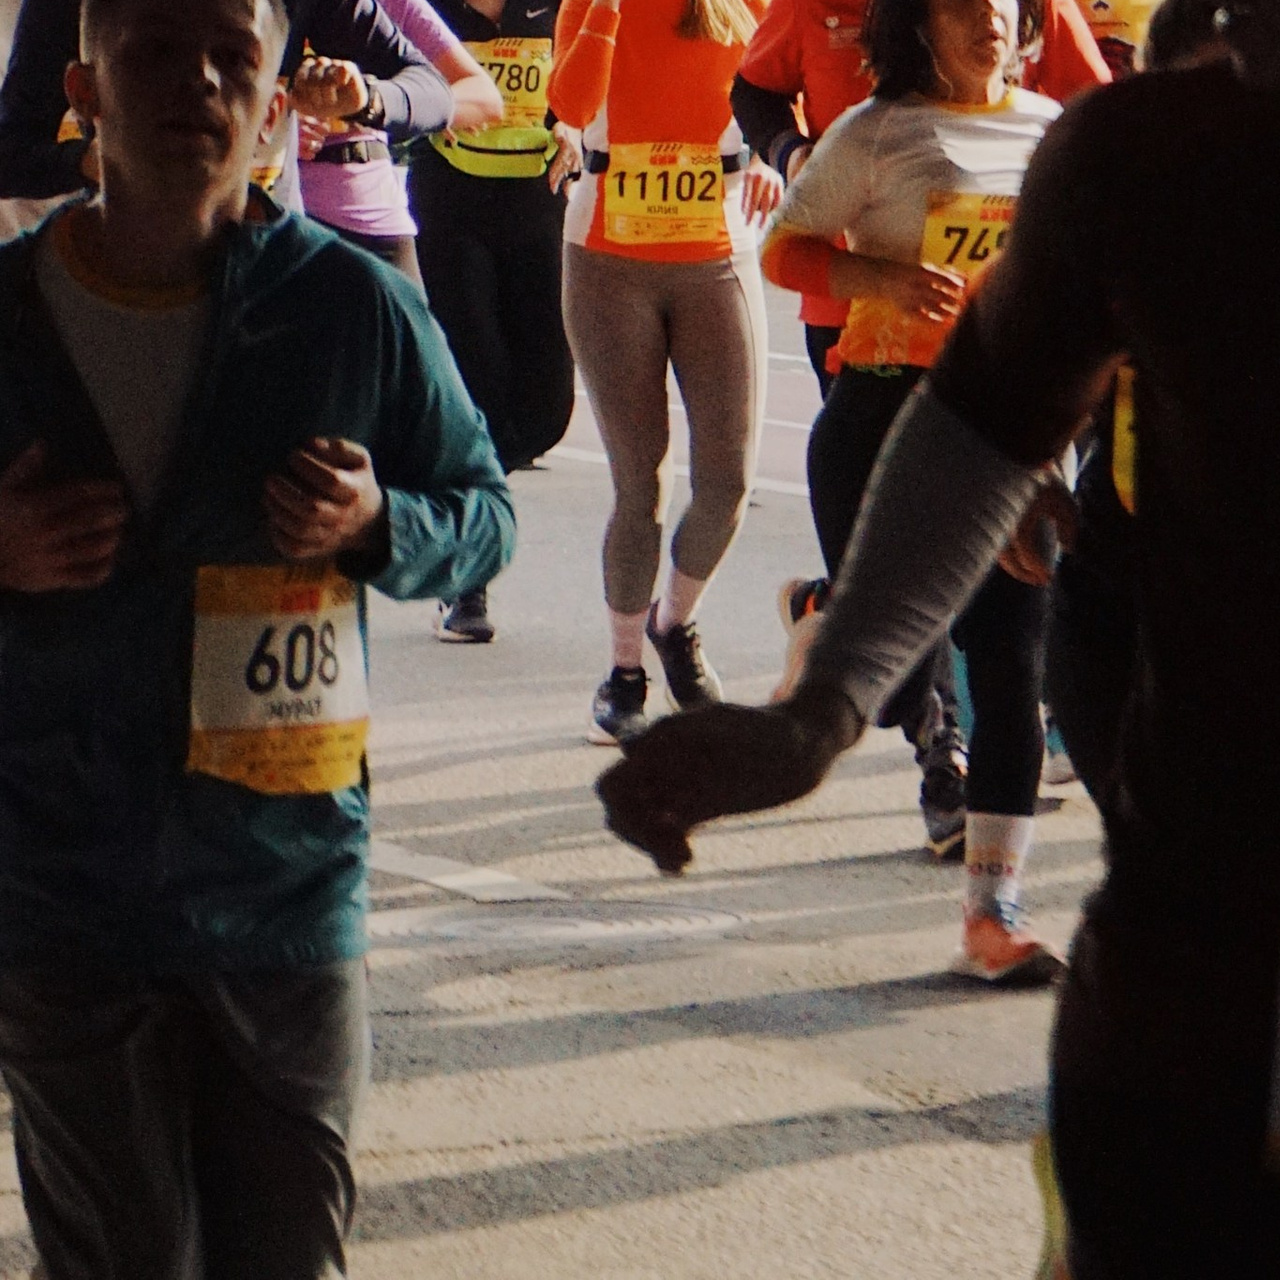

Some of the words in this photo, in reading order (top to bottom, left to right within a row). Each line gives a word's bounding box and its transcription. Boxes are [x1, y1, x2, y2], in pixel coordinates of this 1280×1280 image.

[478, 61, 540, 93] 780
[613, 170, 717, 202] 11102
[246, 620, 339, 694] 608
